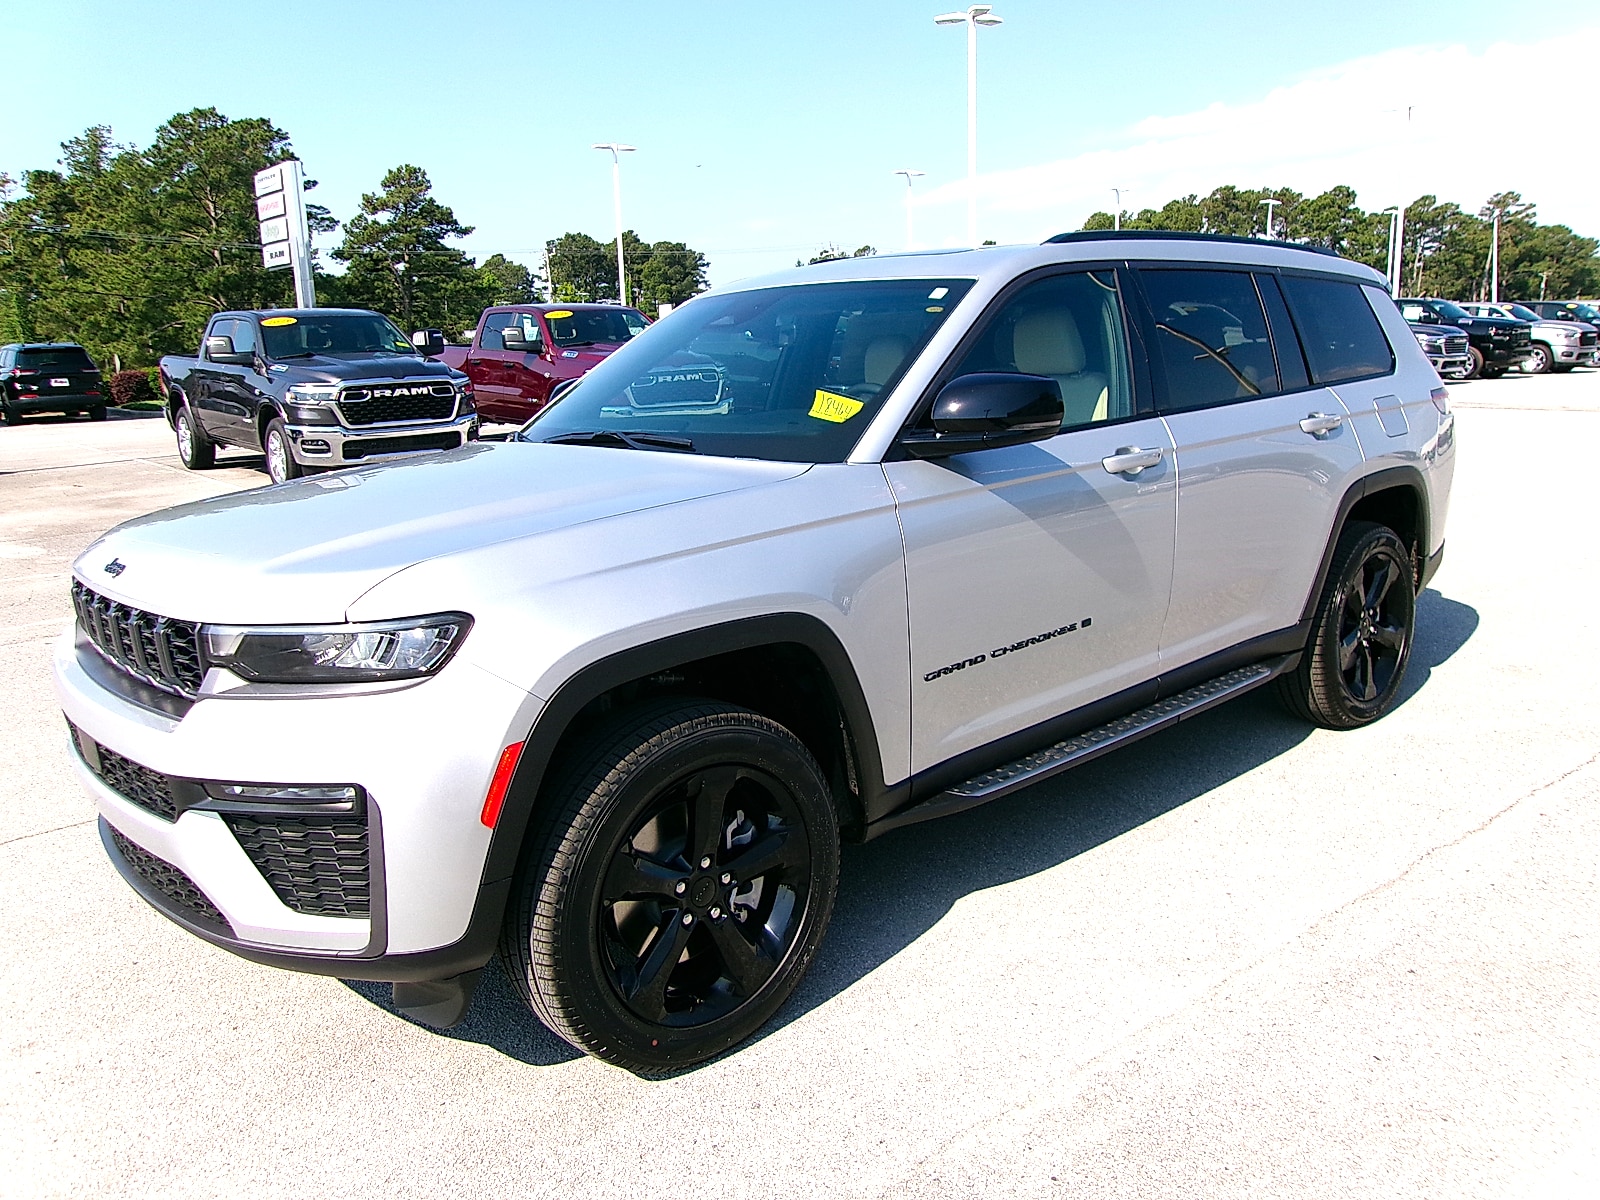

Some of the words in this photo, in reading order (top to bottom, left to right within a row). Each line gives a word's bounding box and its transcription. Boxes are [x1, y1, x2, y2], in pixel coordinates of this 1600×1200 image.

[269, 250, 285, 259] RAM
[658, 374, 699, 382] RAM
[373, 386, 428, 398] RAM
[923, 653, 986, 682] GRAND
[990, 622, 1078, 659] CHEROKEE
